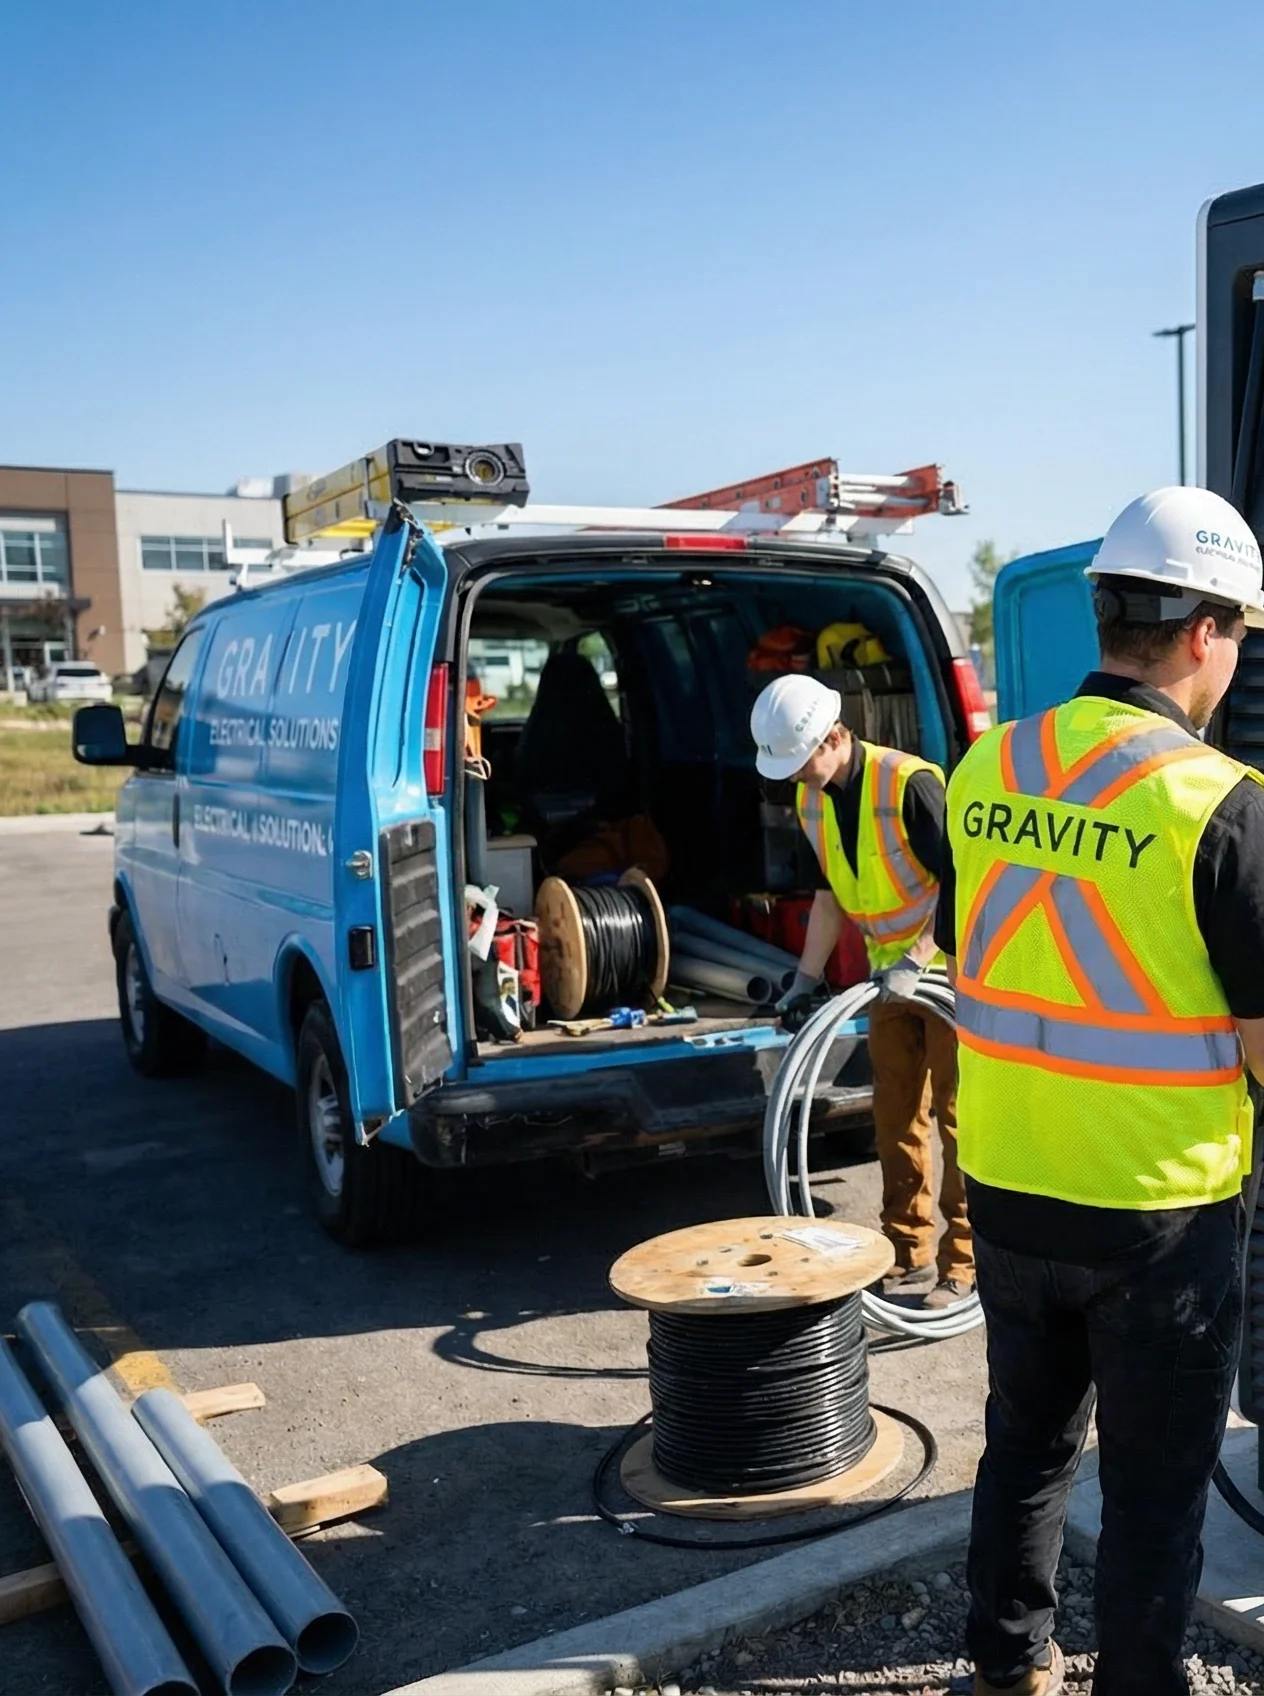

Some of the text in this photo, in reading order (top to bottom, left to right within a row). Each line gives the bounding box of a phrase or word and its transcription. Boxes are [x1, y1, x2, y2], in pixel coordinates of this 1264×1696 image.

[217, 619, 358, 699] GRAITY
[268, 718, 339, 750] SOLUTIONS
[963, 801, 1157, 868] GRAVITY
